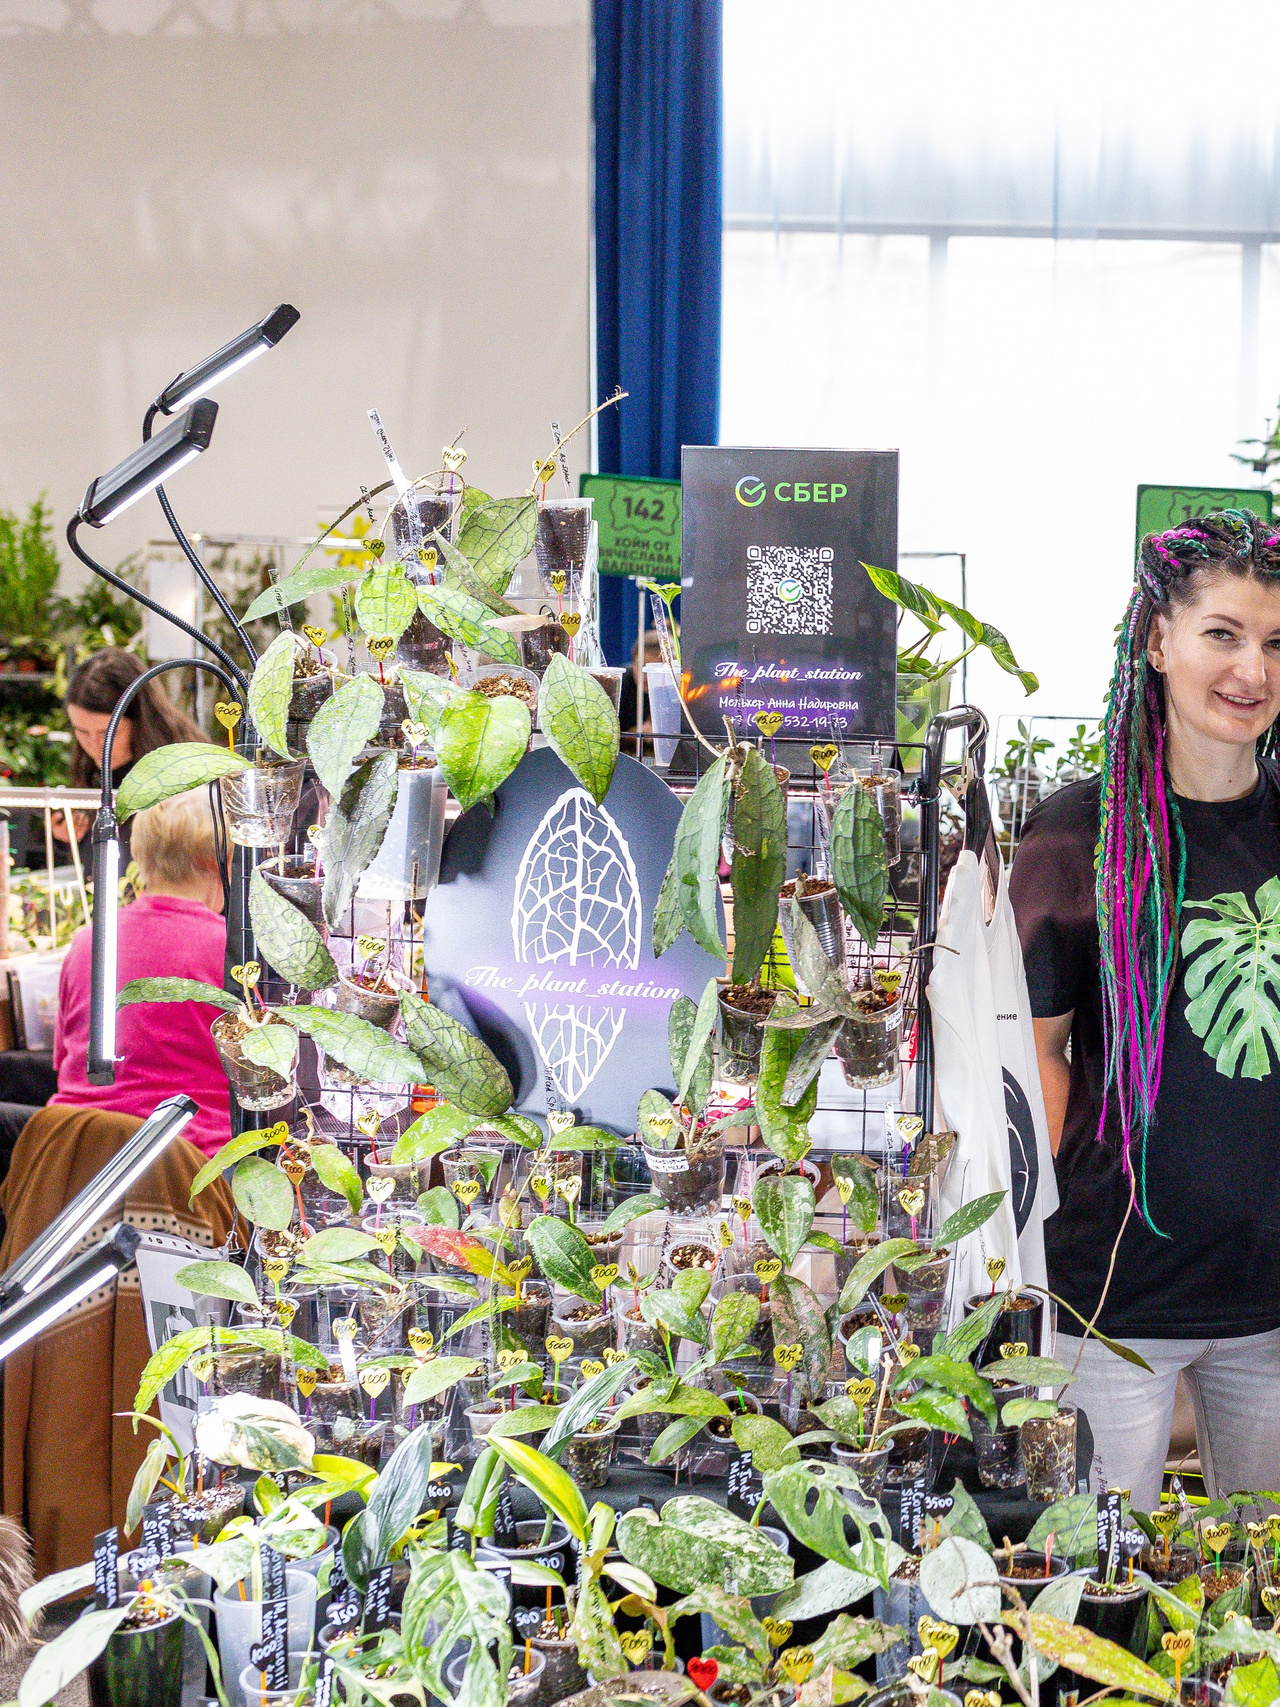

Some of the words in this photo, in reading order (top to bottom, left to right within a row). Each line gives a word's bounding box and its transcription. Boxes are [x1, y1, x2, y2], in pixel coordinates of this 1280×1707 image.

[774, 482, 848, 503] СБЕР
[623, 497, 665, 521] 142
[714, 662, 864, 684] The_plant_station
[767, 697, 796, 708] Анна
[798, 697, 859, 709] Надировна
[464, 966, 686, 1000] The_plant_station
[728, 1461, 741, 1496] Mint
[900, 1487, 913, 1530] Silver
[925, 1496, 953, 1509] 3500
[1096, 1509, 1109, 1552] Silver
[94, 1546, 107, 1594] Silver
[365, 1578, 379, 1615] Mint
[251, 1642, 276, 1662] 1000
